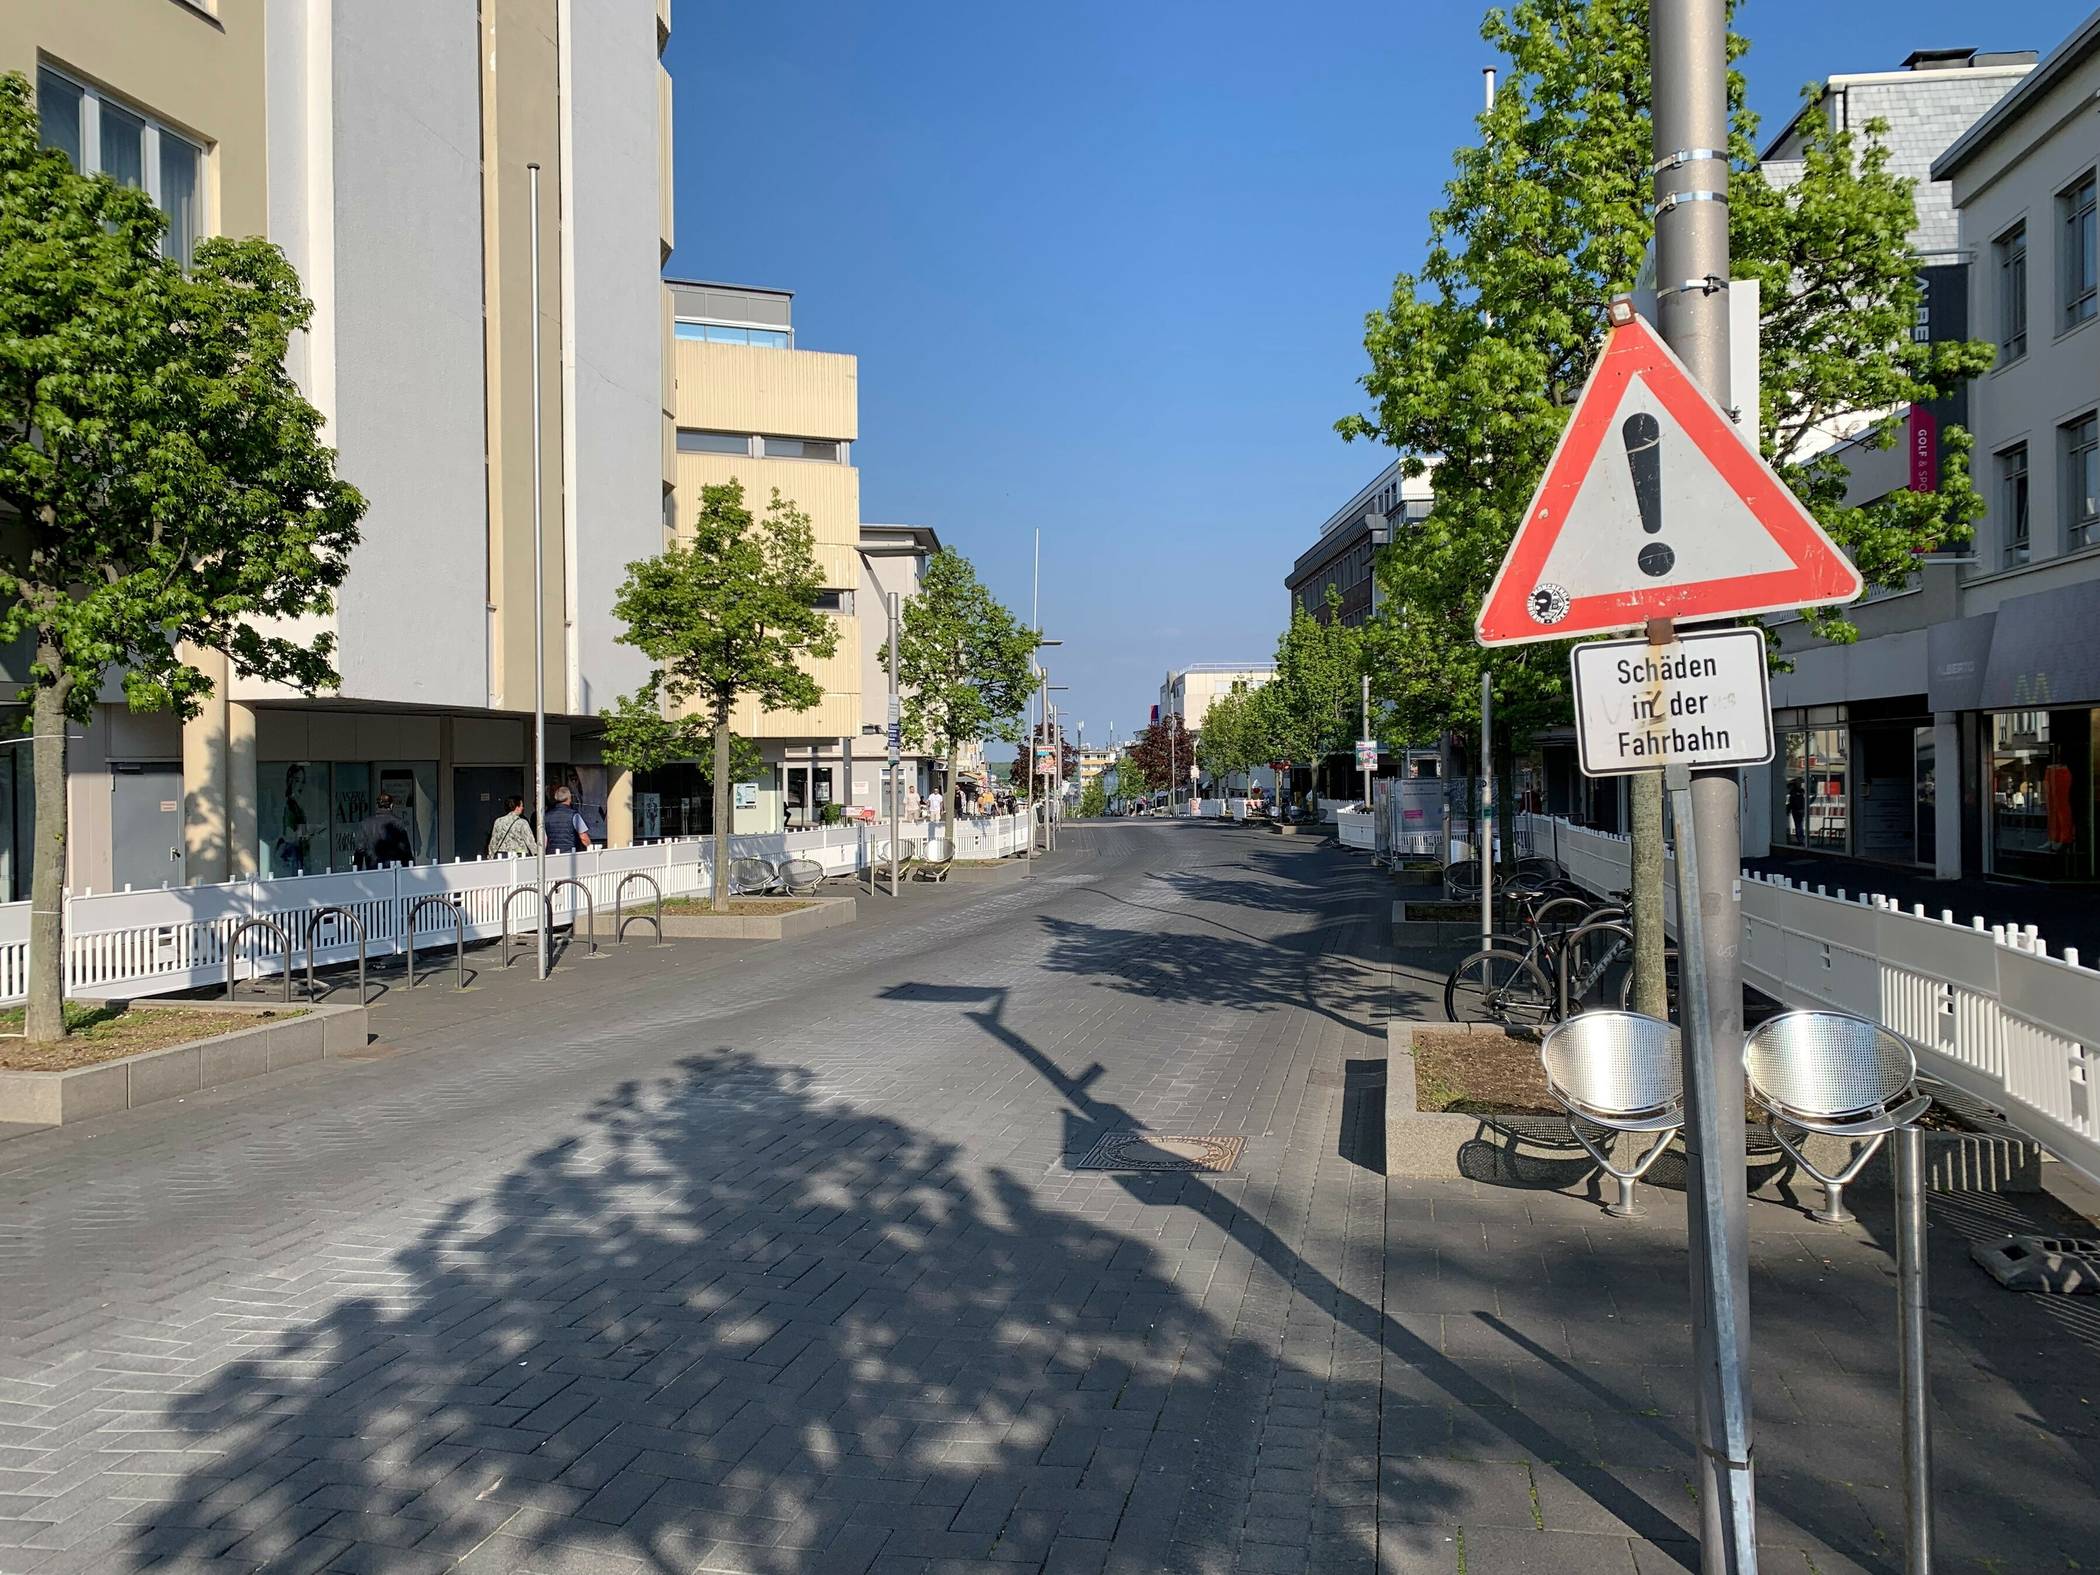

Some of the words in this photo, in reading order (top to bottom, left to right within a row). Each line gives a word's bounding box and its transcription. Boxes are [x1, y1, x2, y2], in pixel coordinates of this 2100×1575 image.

[1918, 429, 1928, 457] GOLF
[1918, 460, 1928, 468] &
[1918, 470, 1928, 492] SPO
[1617, 654, 1717, 684] Schäden
[1632, 694, 1655, 720] in
[1670, 691, 1709, 717] der
[1618, 725, 1730, 757] Fahrbahn
